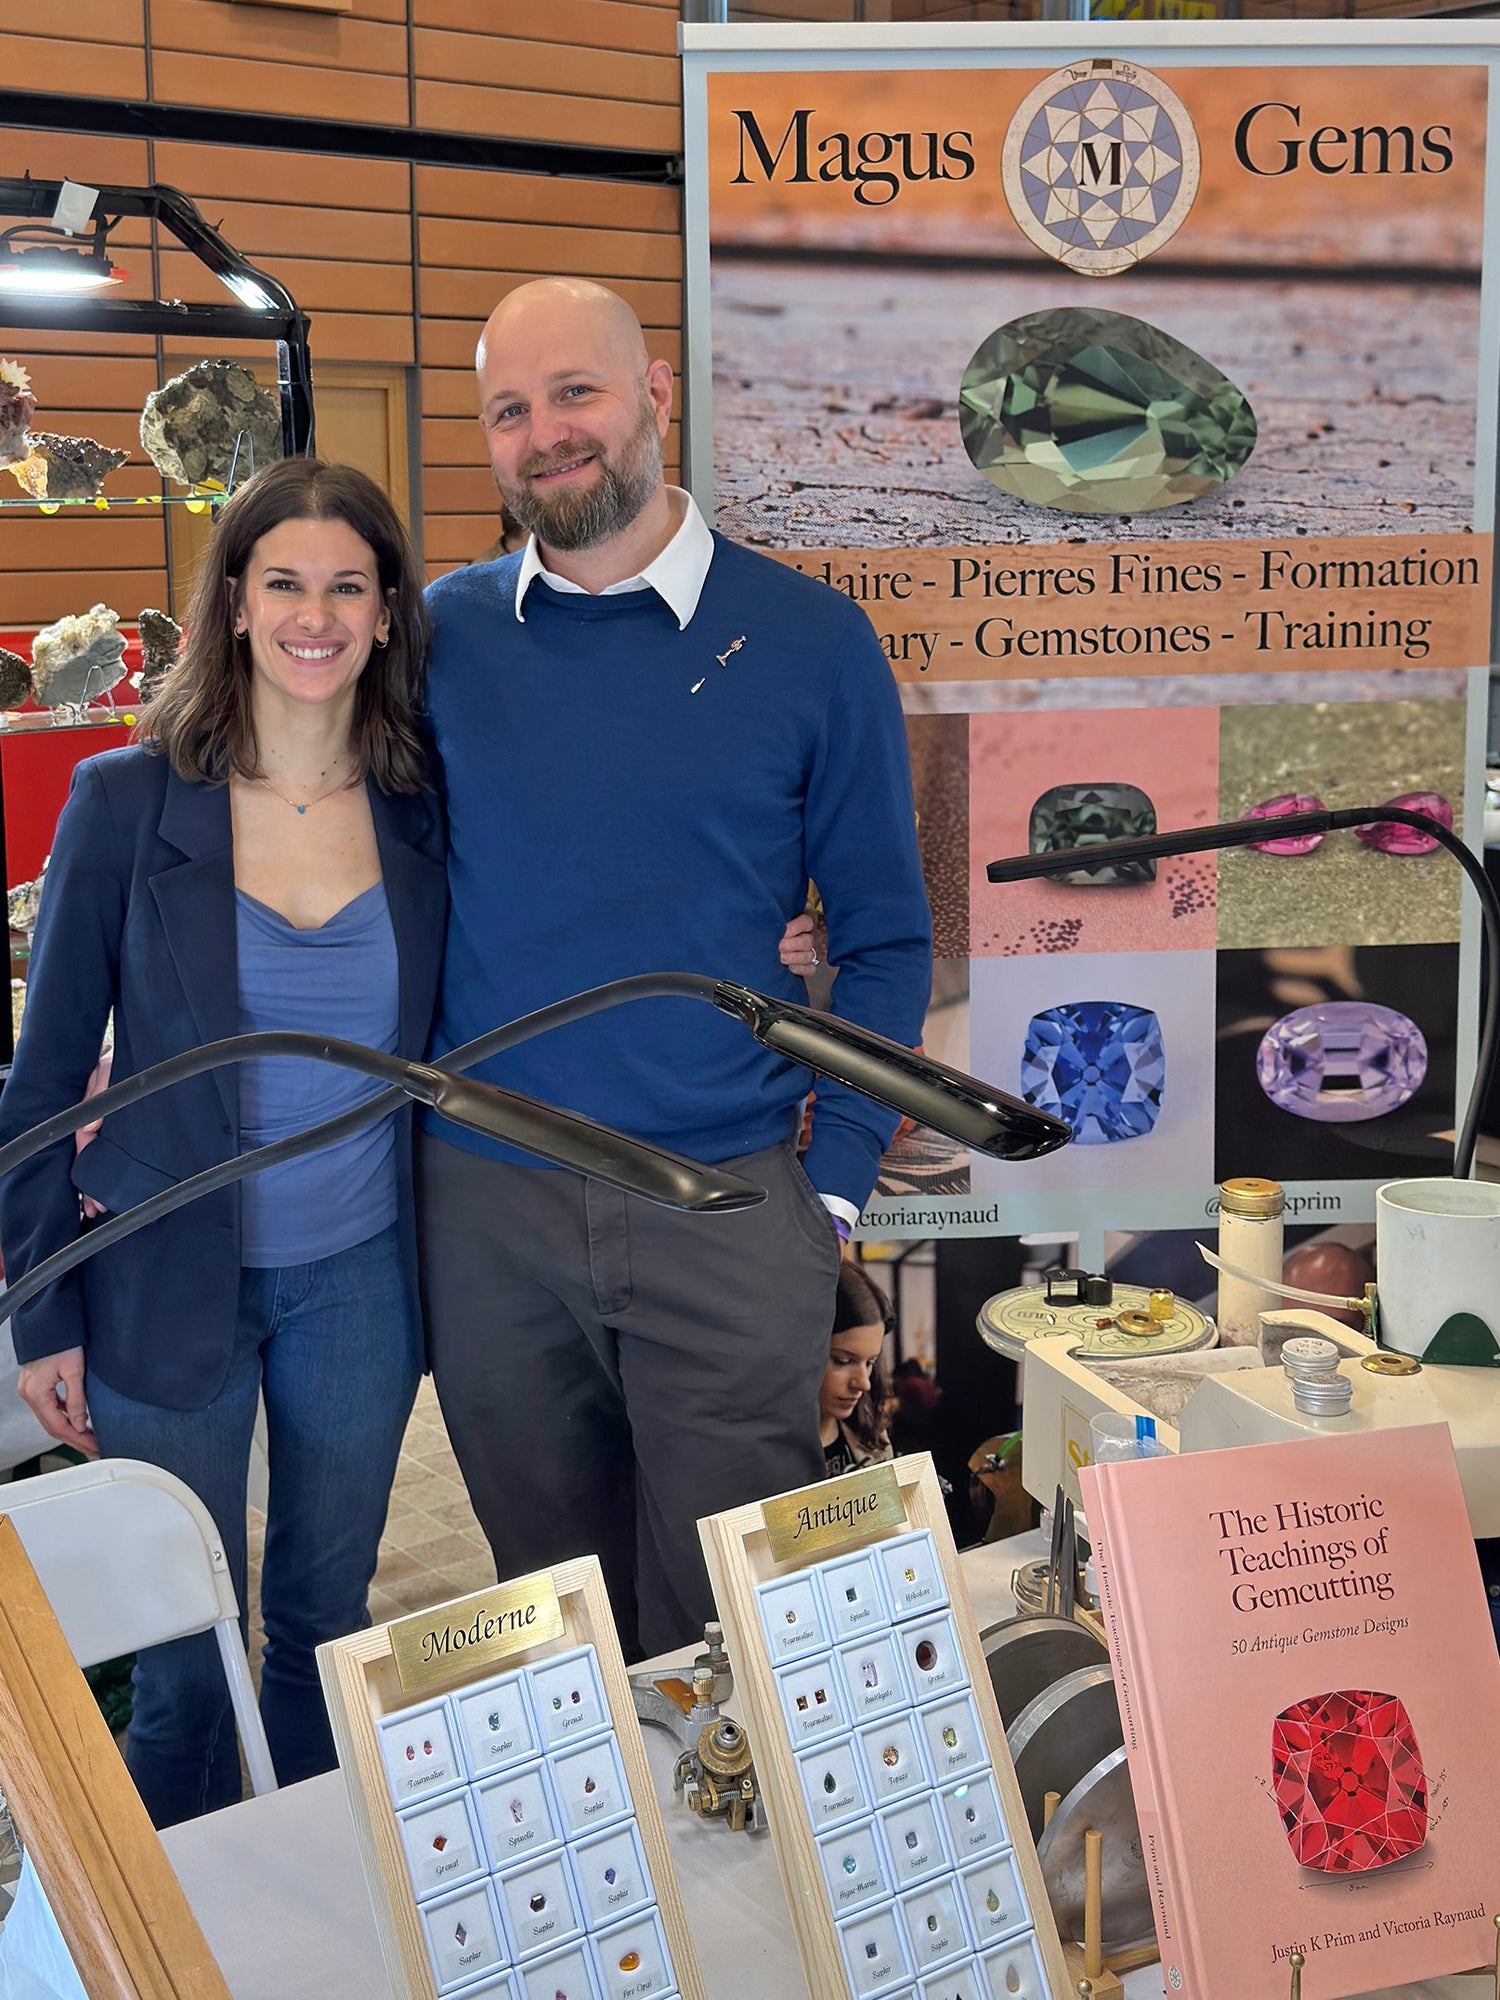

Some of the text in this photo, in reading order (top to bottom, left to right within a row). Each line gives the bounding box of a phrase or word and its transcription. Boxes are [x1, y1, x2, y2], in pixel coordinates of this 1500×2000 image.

[729, 102, 1454, 206] Magus Gems
[1079, 141, 1122, 186] M
[796, 562, 912, 601] daire
[949, 558, 1095, 599] Pierres
[1108, 553, 1222, 594] Fines
[1259, 548, 1480, 591] Formation
[974, 617, 1212, 659] Gemstones
[1244, 610, 1432, 659] Training
[793, 1493, 878, 1539] Antique
[1208, 1493, 1385, 1540] The Historic
[1218, 1526, 1389, 1576] Teachings of
[1231, 1569, 1395, 1613] Gemcutting
[421, 1604, 537, 1662] Moderne
[1231, 1615, 1410, 1656] 50 Antique Gemstone Designs
[1271, 1902, 1487, 1964] Justin K Prim and Victoria Raynaud
